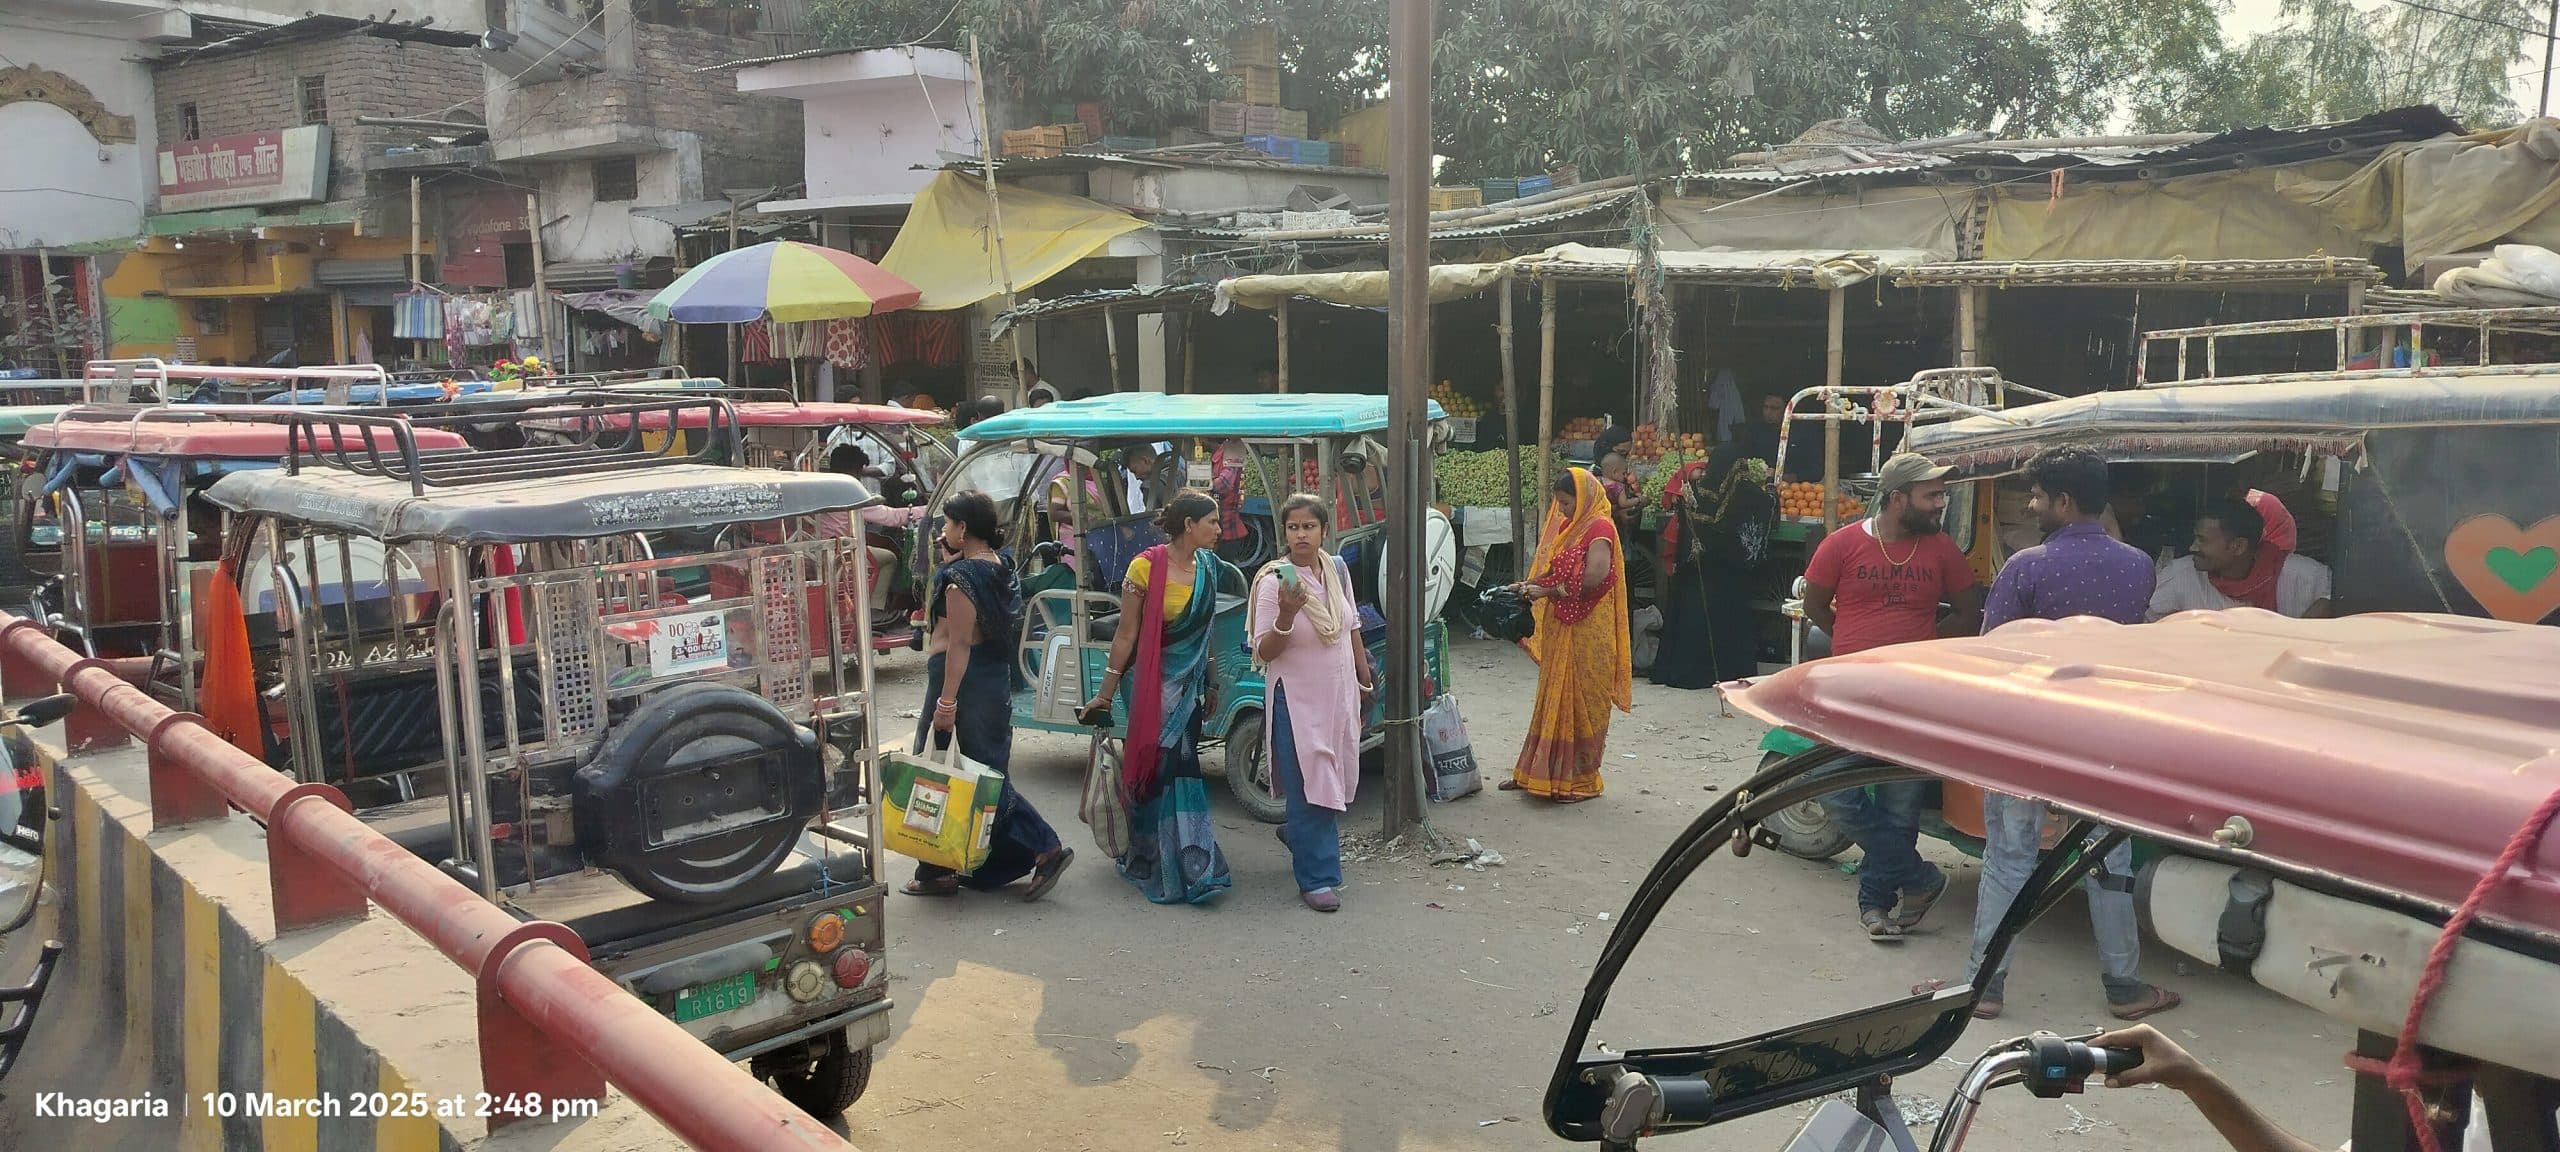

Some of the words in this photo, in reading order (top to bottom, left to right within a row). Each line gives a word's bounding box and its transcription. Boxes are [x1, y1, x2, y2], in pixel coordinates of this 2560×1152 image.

[177, 145, 208, 183] महावीर
[1857, 564, 1934, 581] BALMAIN
[1437, 755, 1469, 770] भारत
[16, 824, 40, 842] Hero
[691, 986, 748, 1017] R1619
